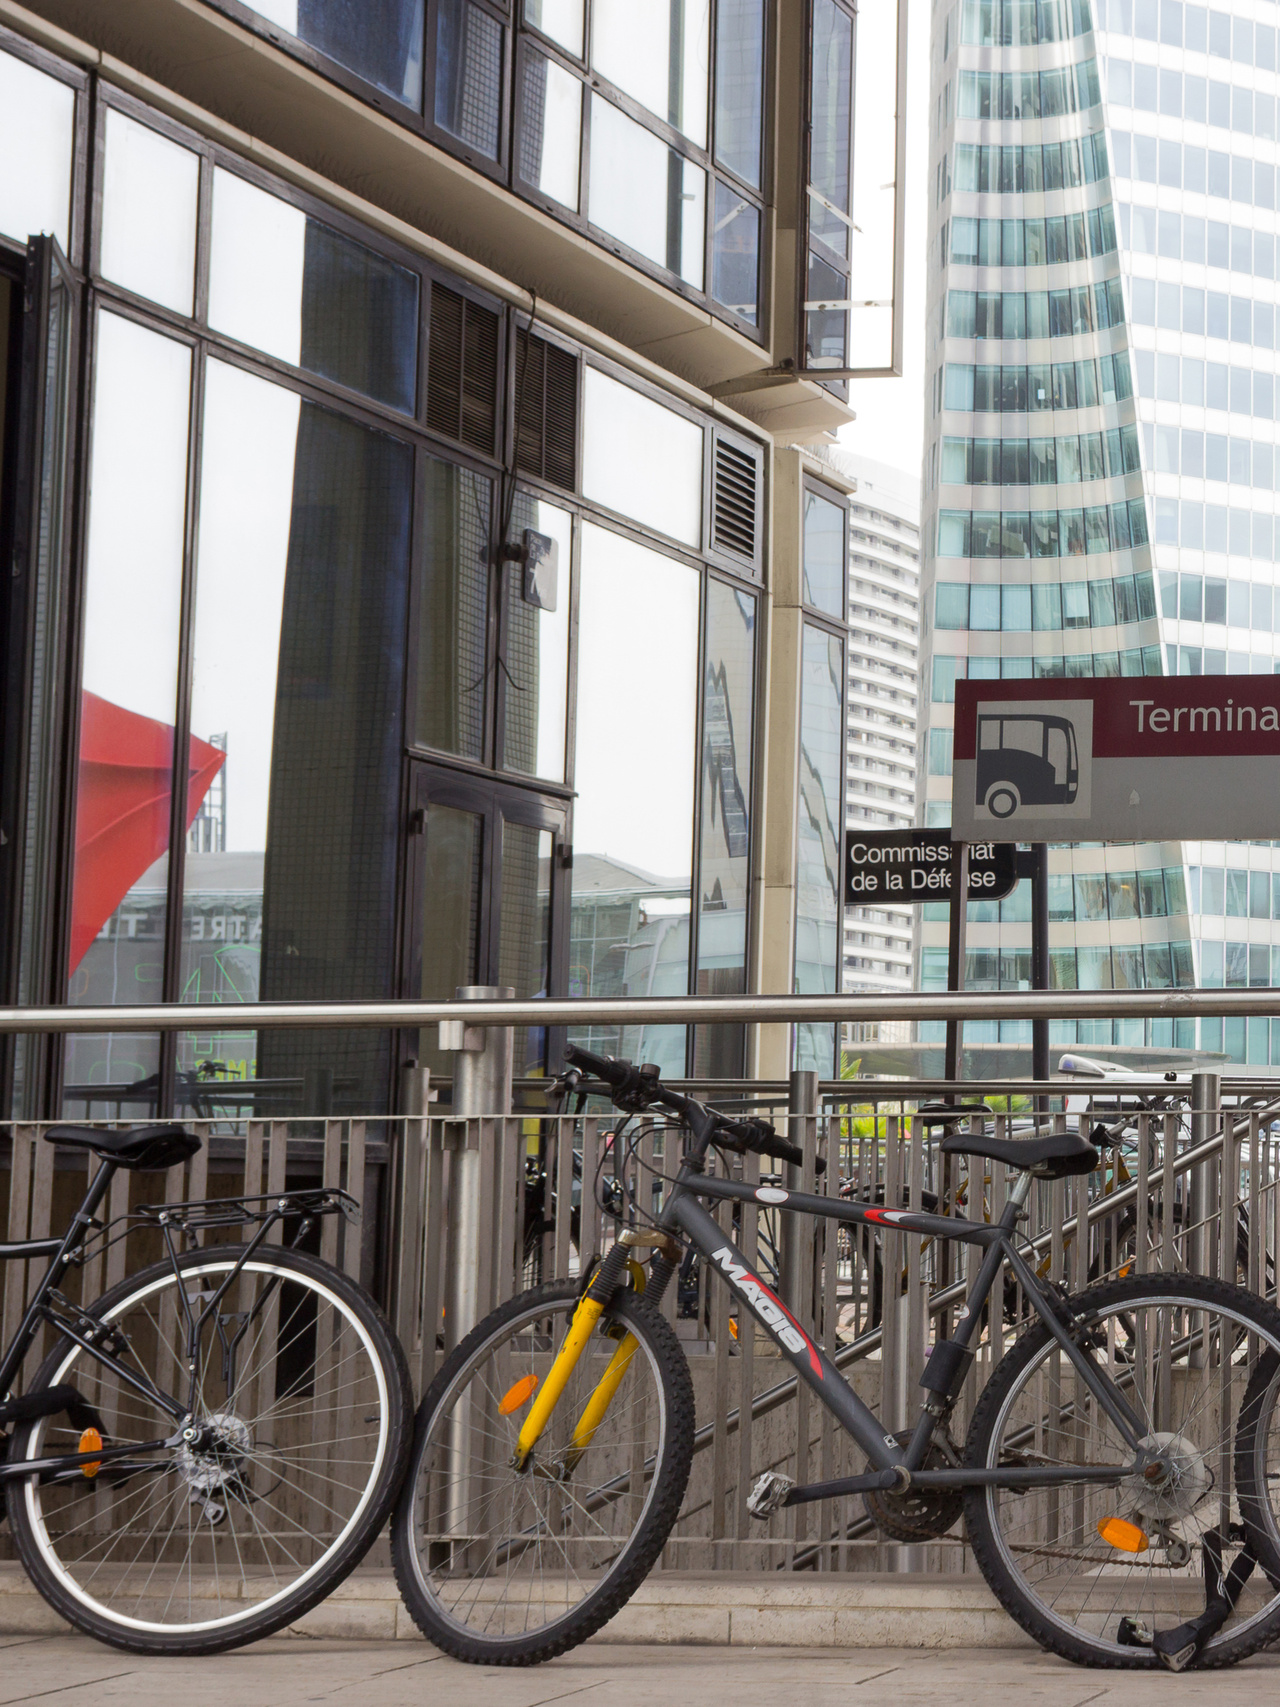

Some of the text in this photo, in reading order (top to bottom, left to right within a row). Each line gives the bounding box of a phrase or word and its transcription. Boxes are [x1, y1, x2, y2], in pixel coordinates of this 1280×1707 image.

[850, 842, 995, 864] Commissiat
[851, 868, 996, 891] de la Défese
[711, 1246, 807, 1354] MAGIS
